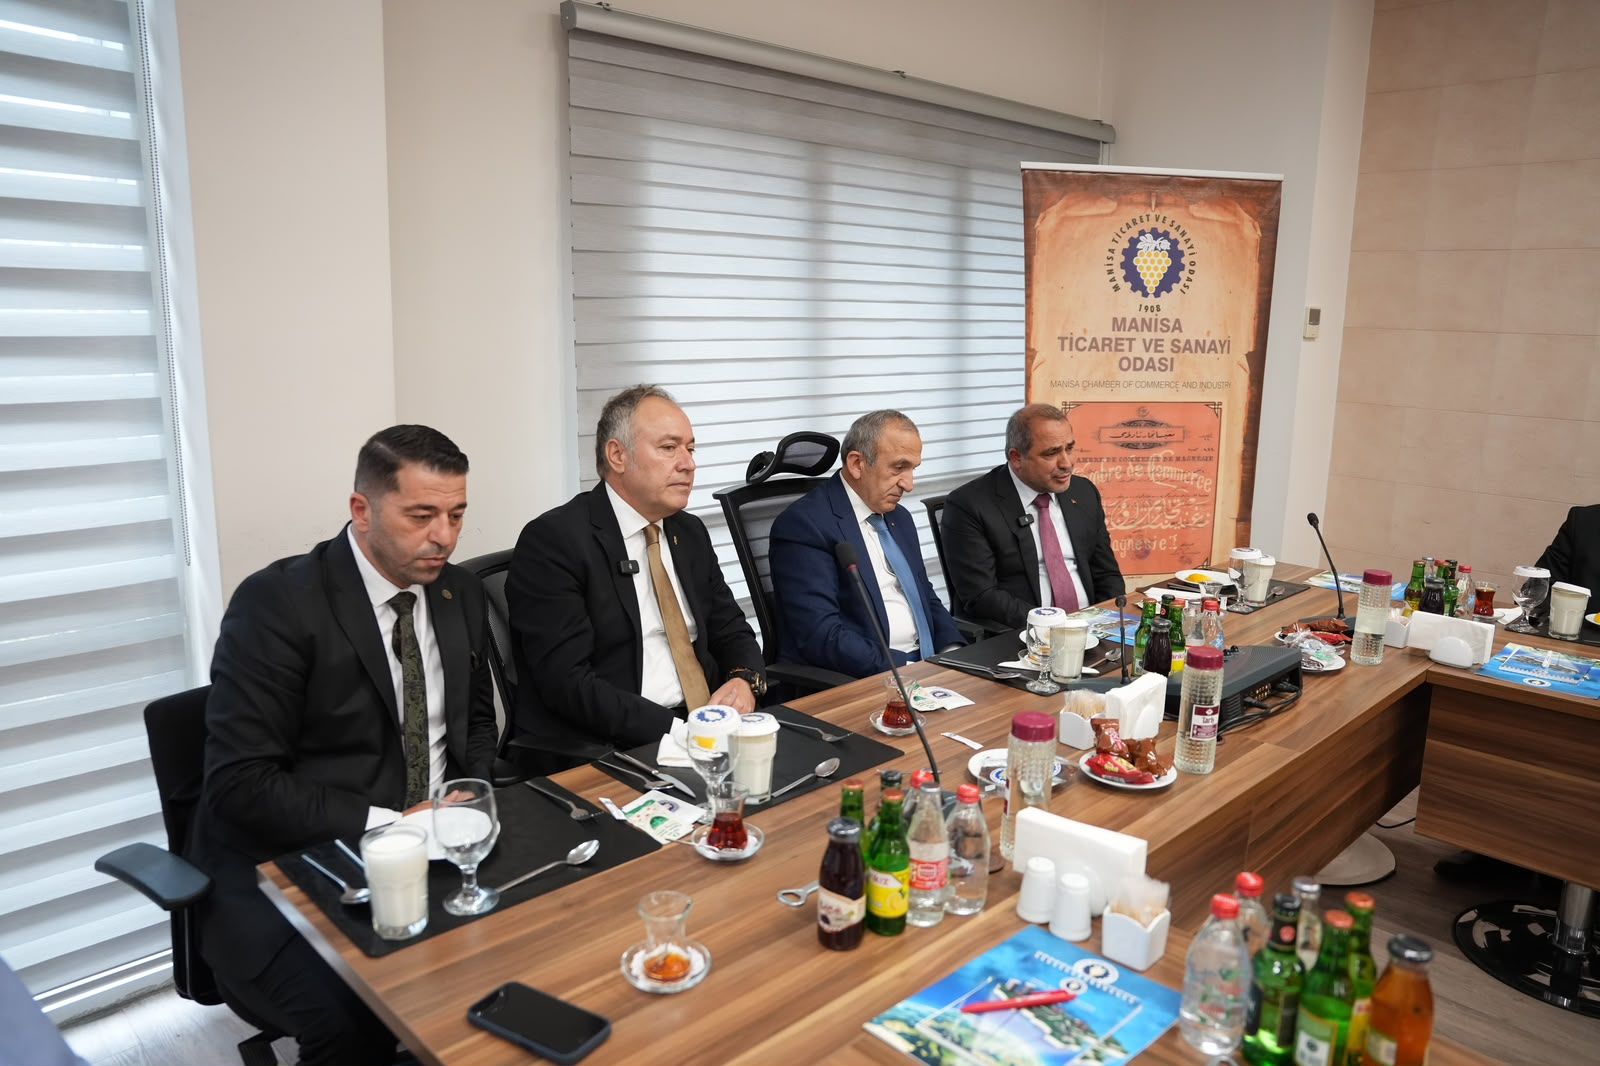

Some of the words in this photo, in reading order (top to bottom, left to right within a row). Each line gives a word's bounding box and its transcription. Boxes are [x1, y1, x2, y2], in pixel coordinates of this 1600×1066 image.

[1111, 214, 1151, 244] TİCARET
[1154, 214, 1168, 224] VE
[1169, 219, 1198, 256] SANAYİ
[1104, 247, 1121, 293] MANİSA
[1179, 260, 1197, 295] ODASI
[1138, 303, 1162, 313] 1908
[1111, 313, 1183, 333] MANİSA
[1057, 332, 1137, 353] TİCARET
[1142, 338, 1165, 354] VE
[1170, 336, 1232, 355] SANAYİ
[1118, 356, 1175, 372] ODASI
[1081, 380, 1121, 389] CHAMBER
[1122, 381, 1133, 389] OF
[1134, 381, 1180, 389] COMMERCE
[1181, 381, 1198, 390] AND
[1199, 382, 1232, 390] INDUSTRY
